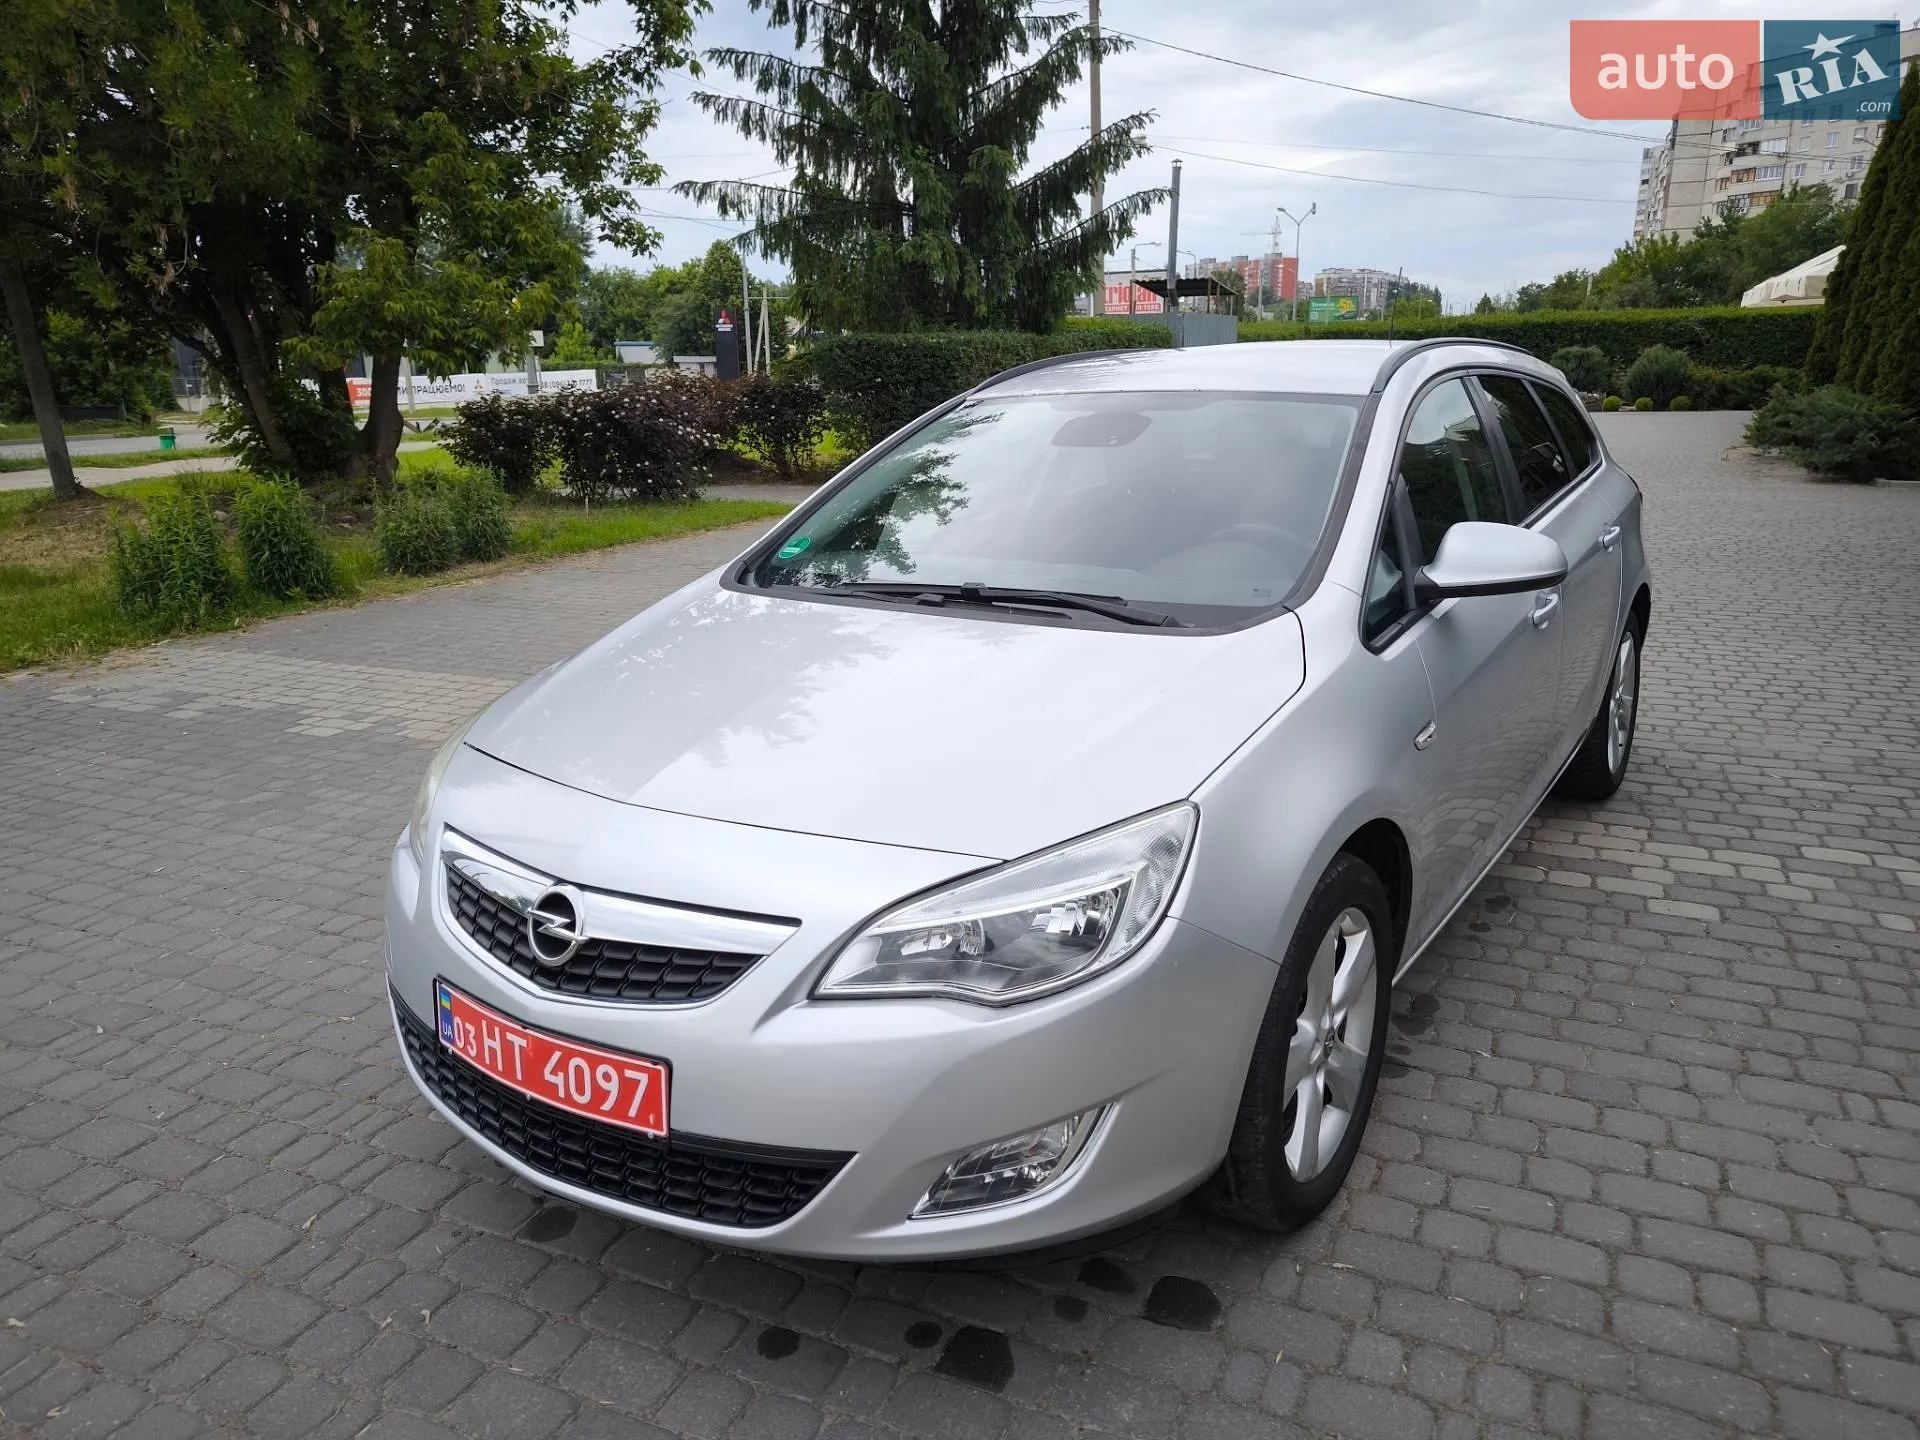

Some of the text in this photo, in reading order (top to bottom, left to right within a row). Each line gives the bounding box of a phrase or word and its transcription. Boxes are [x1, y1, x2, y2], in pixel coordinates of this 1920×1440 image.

[442, 1020, 453, 1039] UA
[454, 1016, 649, 1118] 03 HT 4097
